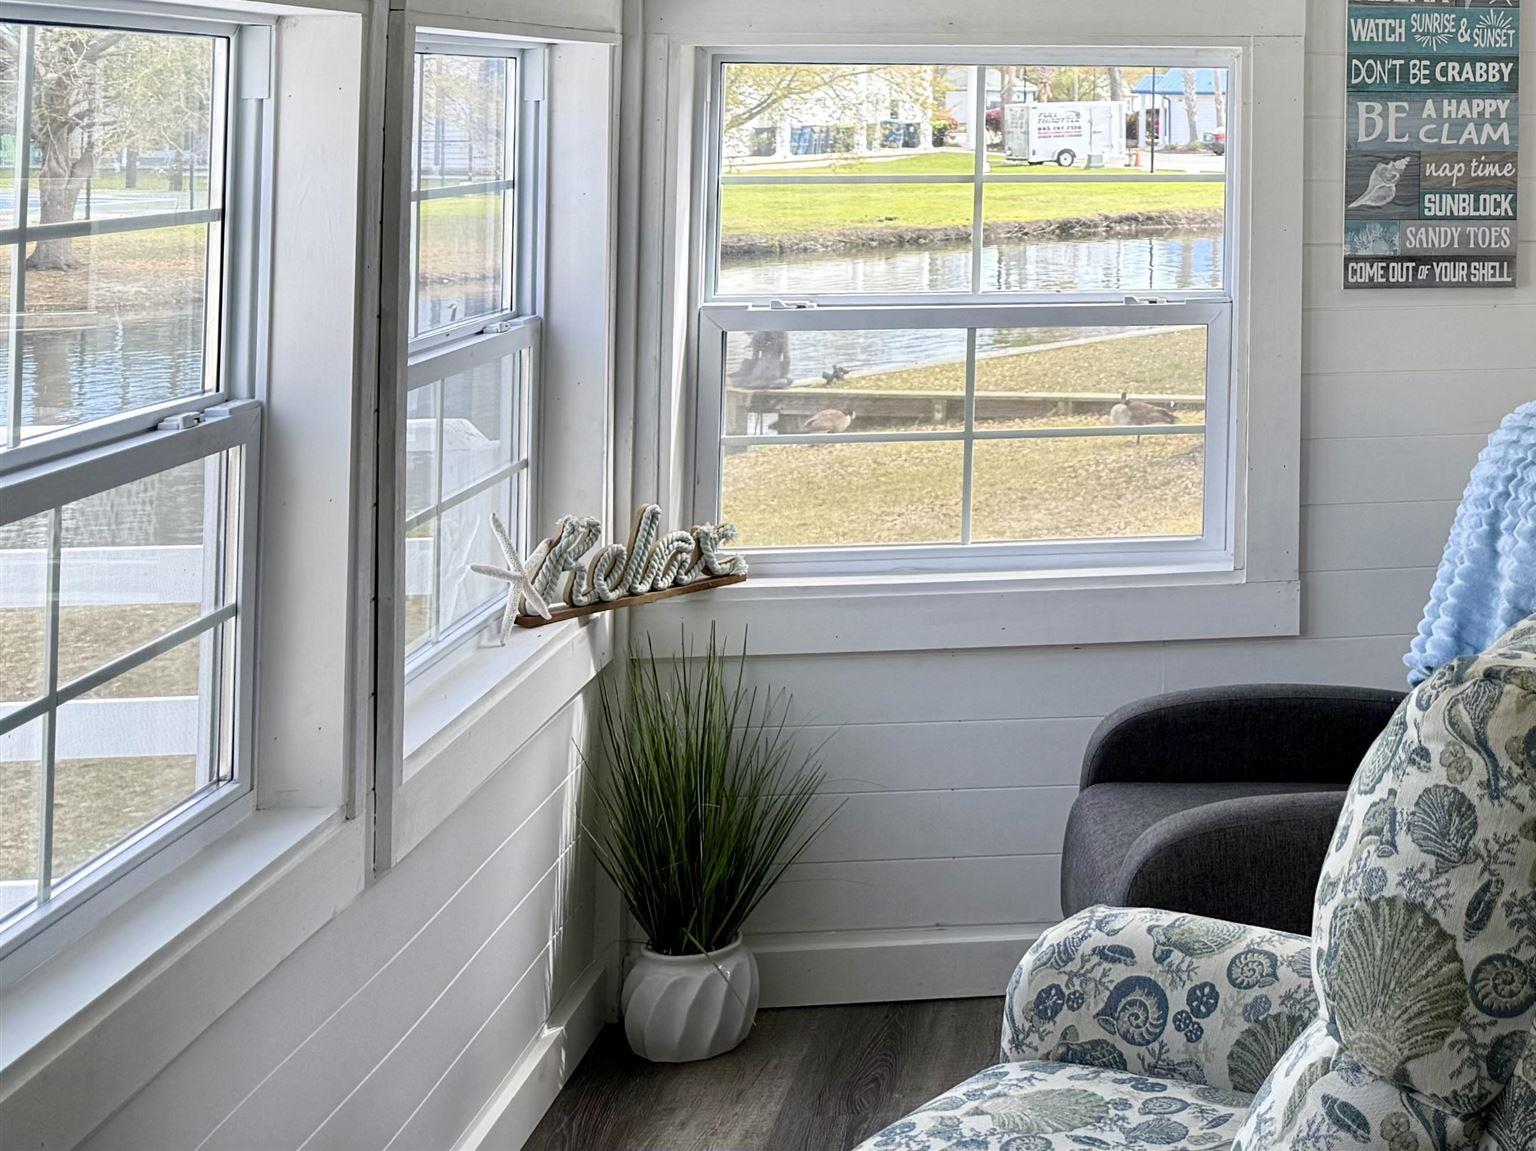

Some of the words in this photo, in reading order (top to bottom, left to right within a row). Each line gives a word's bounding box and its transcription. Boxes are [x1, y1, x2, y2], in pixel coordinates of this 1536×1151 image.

[1350, 18, 1406, 42] WATCH
[1410, 13, 1456, 33] SUNRISE
[1457, 18, 1470, 43] &
[1473, 28, 1515, 48] SUNSET
[1351, 58, 1405, 85] DON'T
[1409, 59, 1430, 85] BE
[1435, 61, 1514, 83] CRABBY
[1356, 101, 1409, 143] BE
[1422, 99, 1437, 119] A
[1443, 99, 1511, 119] HAPPY
[1419, 122, 1511, 146] CLAM
[1425, 162, 1465, 186] nap
[1470, 156, 1516, 177] time
[1424, 194, 1513, 217] SUNBLOCK
[1406, 227, 1461, 249] SANDY
[1466, 227, 1511, 249] TOES
[1348, 262, 1386, 283] COME
[1389, 262, 1415, 283] OUT
[1418, 266, 1431, 280] OF
[1433, 262, 1467, 282] YOUR
[1470, 262, 1512, 282] SHELL
